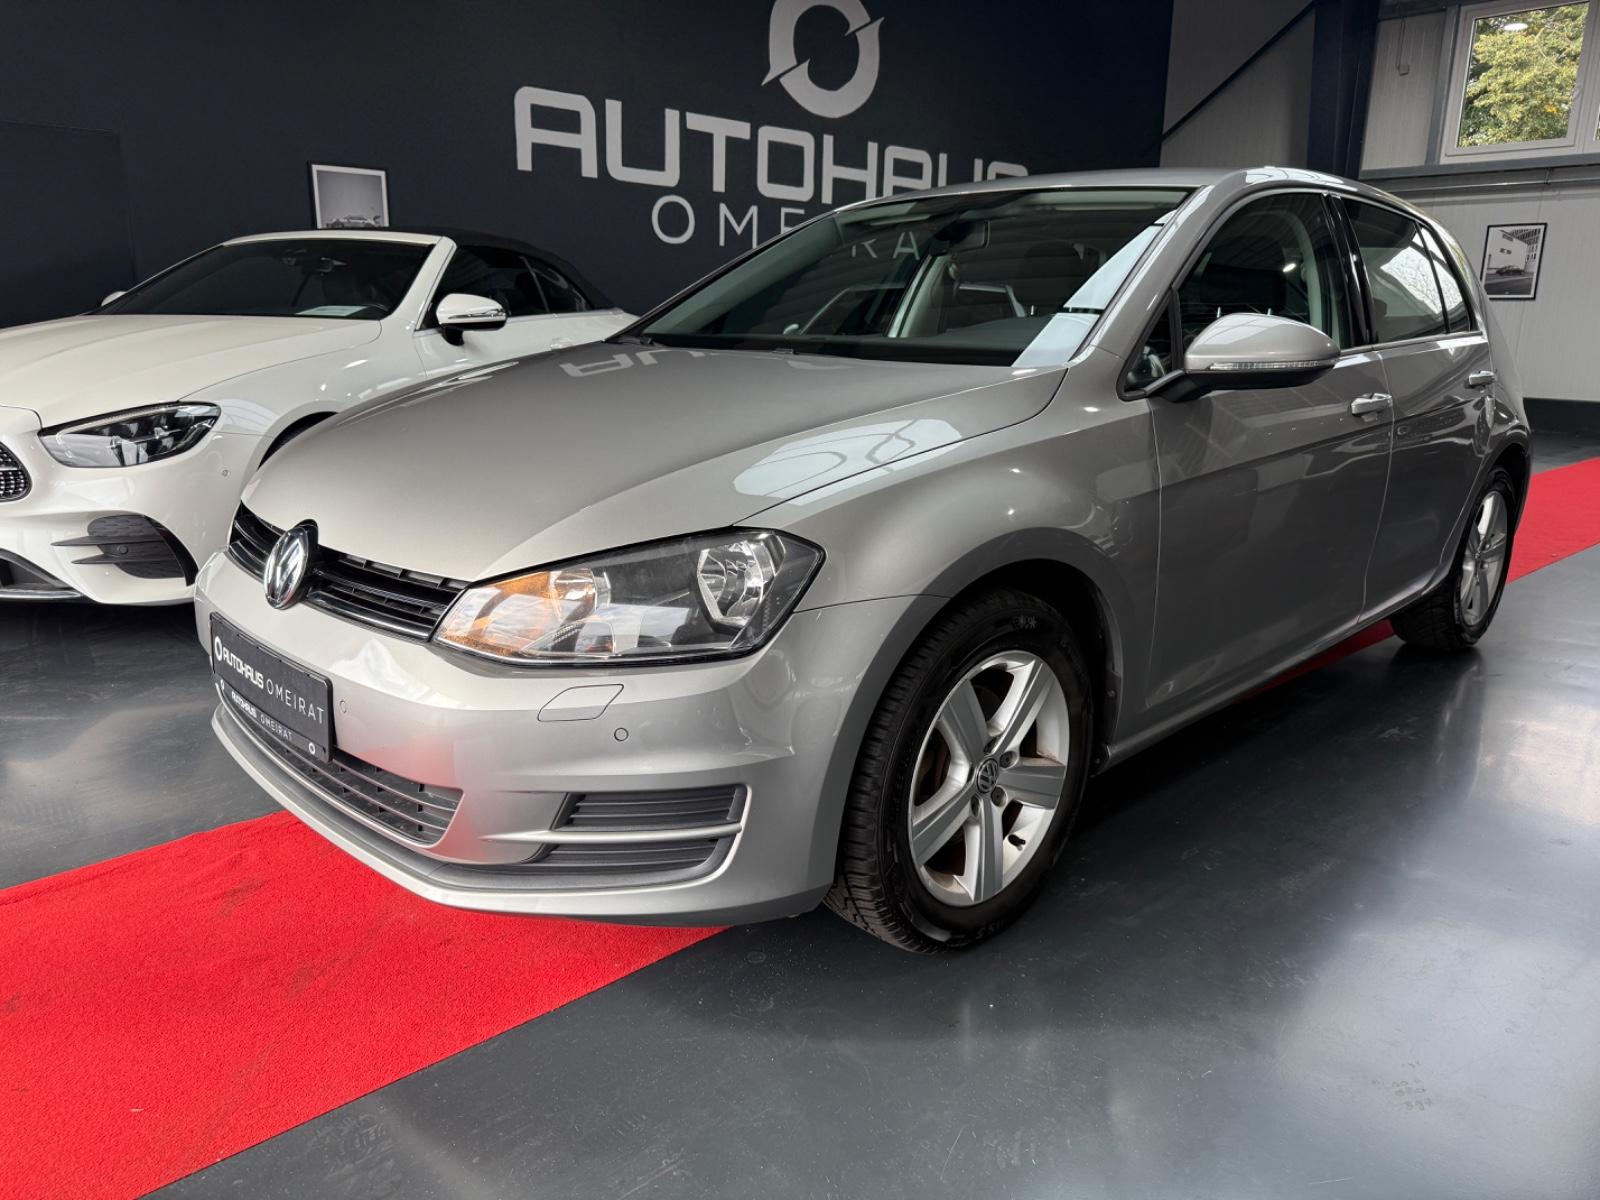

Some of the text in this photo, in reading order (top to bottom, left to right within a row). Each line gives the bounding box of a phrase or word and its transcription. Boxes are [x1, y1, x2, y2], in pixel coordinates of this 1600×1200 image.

[514, 86, 1029, 204] AUTOHA
[222, 646, 325, 724] AUTOHAUS OMEIRAT
[260, 714, 293, 741] OMEIRAT
